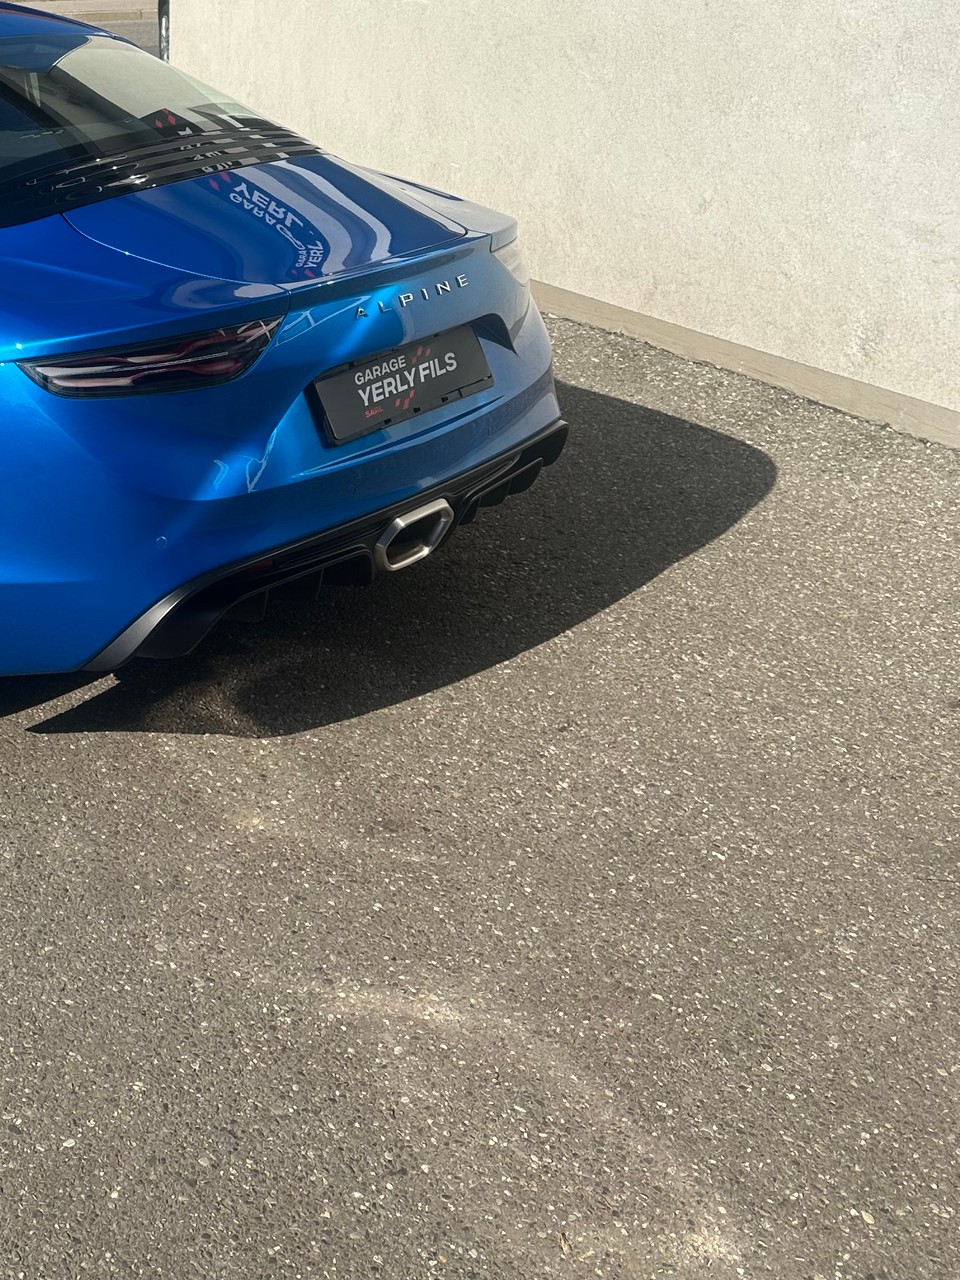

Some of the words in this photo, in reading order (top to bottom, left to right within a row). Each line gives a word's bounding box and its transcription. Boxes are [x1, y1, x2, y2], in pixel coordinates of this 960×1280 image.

[355, 273, 469, 319] ALPINE
[354, 355, 407, 386] GARAGE
[358, 367, 416, 407] YERLY
[419, 352, 458, 384] FILS
[365, 405, 384, 419] SARL
